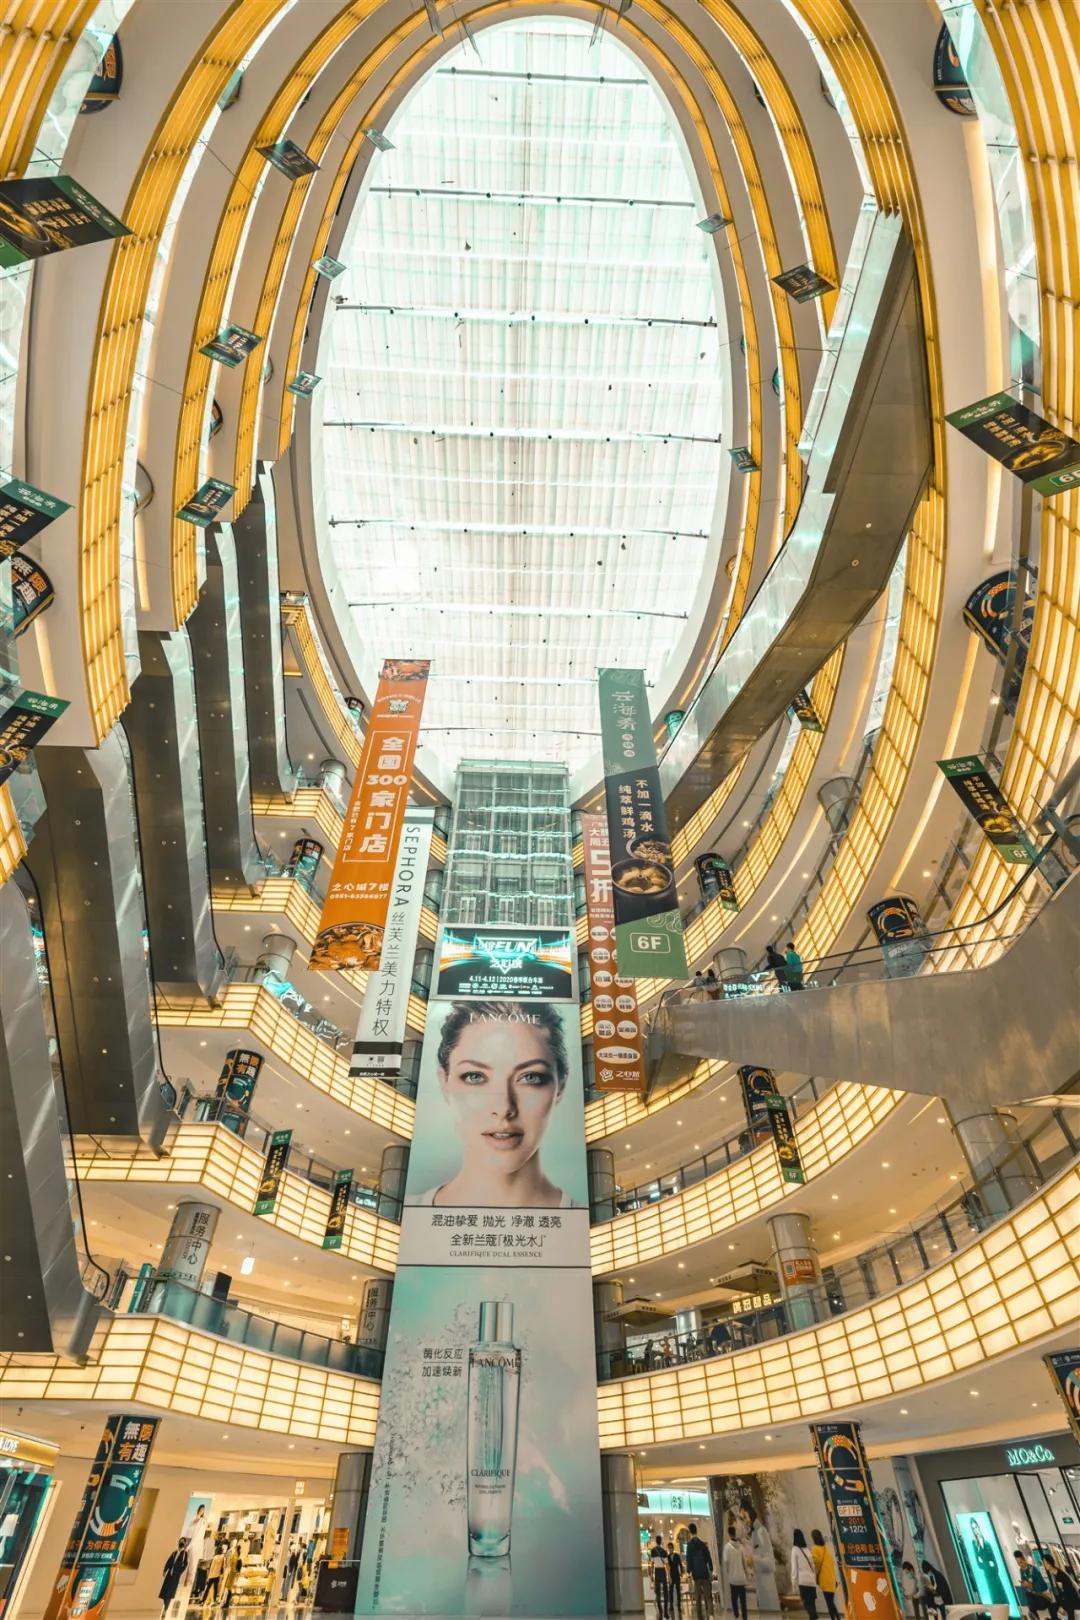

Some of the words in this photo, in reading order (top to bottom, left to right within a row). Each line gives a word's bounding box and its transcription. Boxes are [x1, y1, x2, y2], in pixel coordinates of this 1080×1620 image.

[394, 826, 420, 907] SEPHORA
[637, 935, 662, 950] 6F
[371, 912, 405, 1036] 丝芙兰美力特权
[538, 1215, 562, 1228] 透亮
